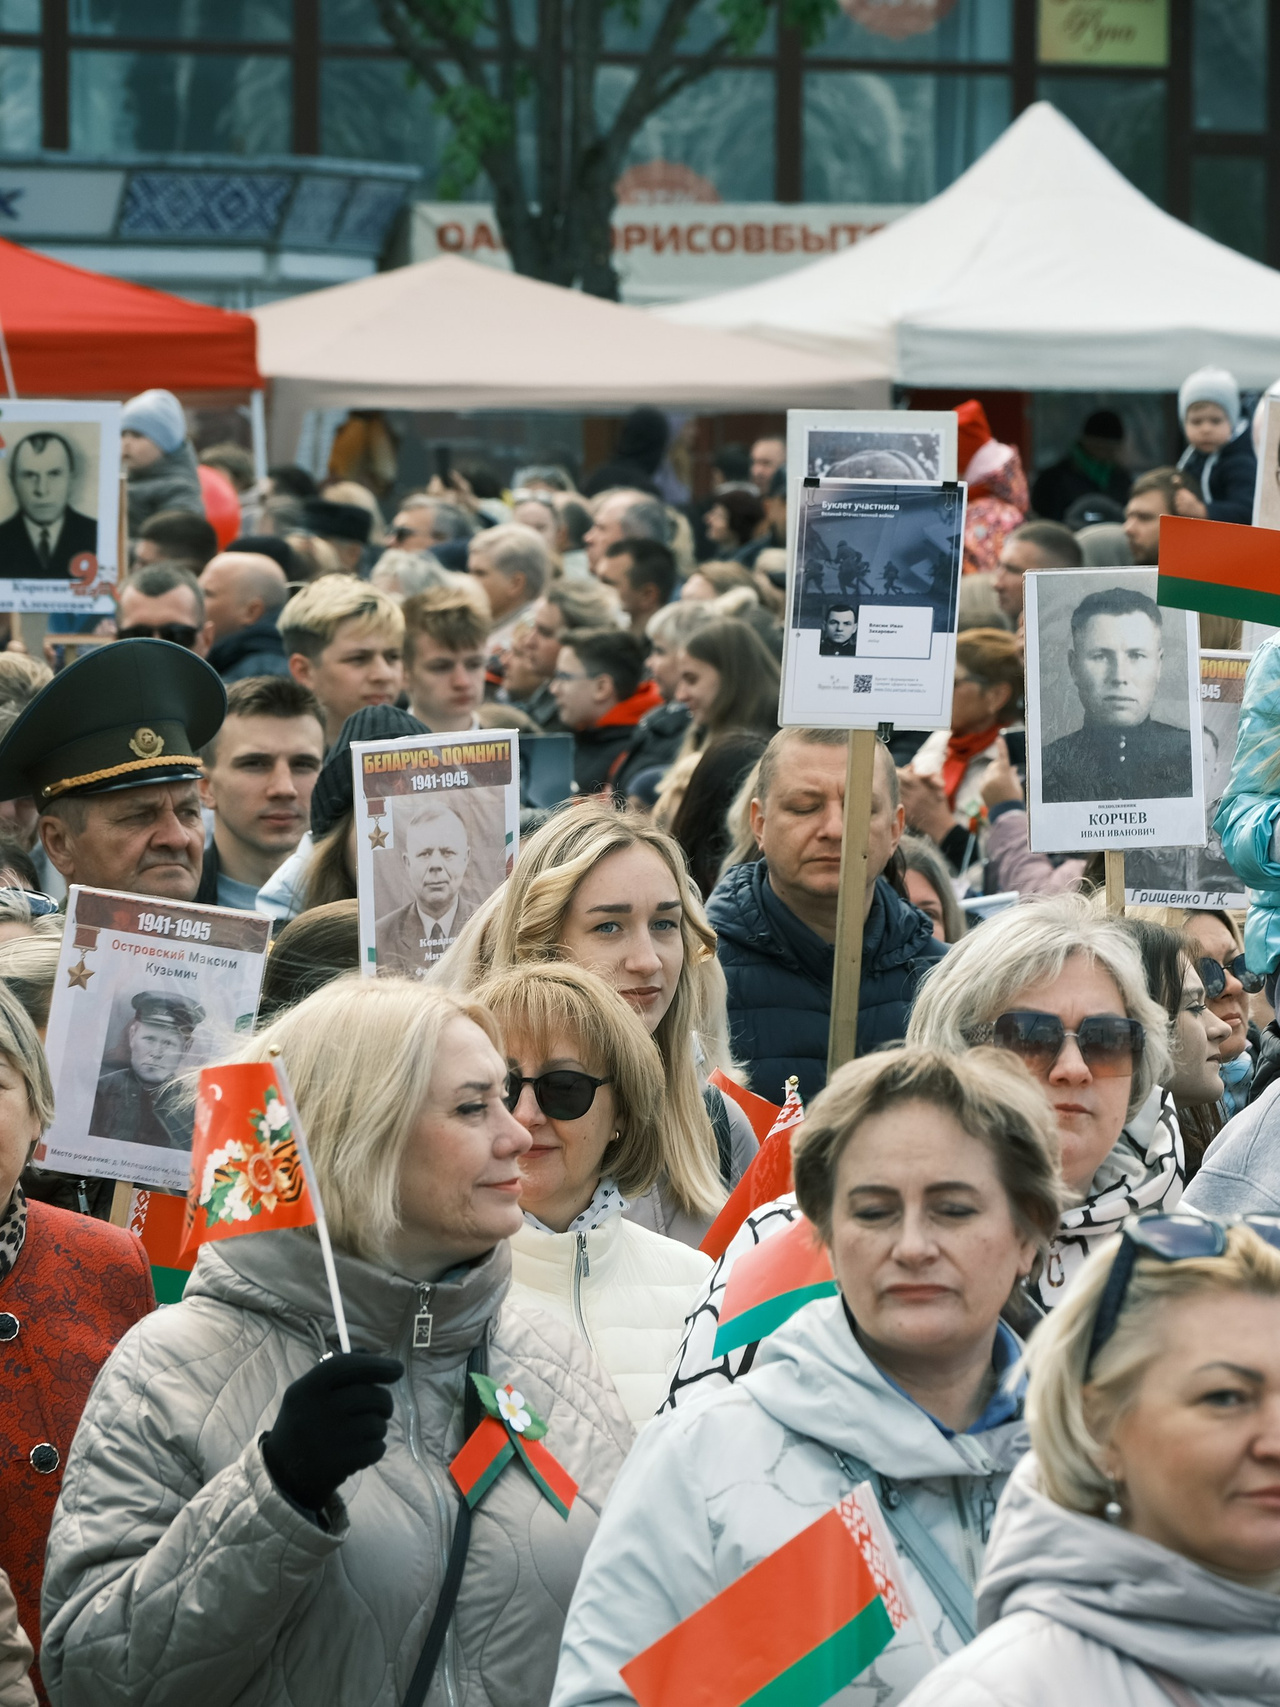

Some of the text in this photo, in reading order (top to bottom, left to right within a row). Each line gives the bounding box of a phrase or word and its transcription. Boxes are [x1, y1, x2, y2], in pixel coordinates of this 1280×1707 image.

[436, 222, 505, 253] ОА
[822, 501, 900, 512] Буклет участника
[1201, 659, 1250, 680] ПОМНИ
[363, 742, 510, 775] БЕЛАРУСЬ ПОМНИТ!
[410, 770, 469, 791] 1941-1945
[1089, 811, 1147, 826] КОРЧЕВ
[1080, 828, 1155, 838] ИВАН ИВАНОВИЧ
[1131, 889, 1229, 906] Грищенко Г.К.
[138, 912, 212, 941] 1941-1945
[112, 939, 237, 969] Островский Максим
[145, 962, 199, 981] Кузьмич
[51, 1148, 73, 1158] Место
[73, 1153, 112, 1165] рождения:
